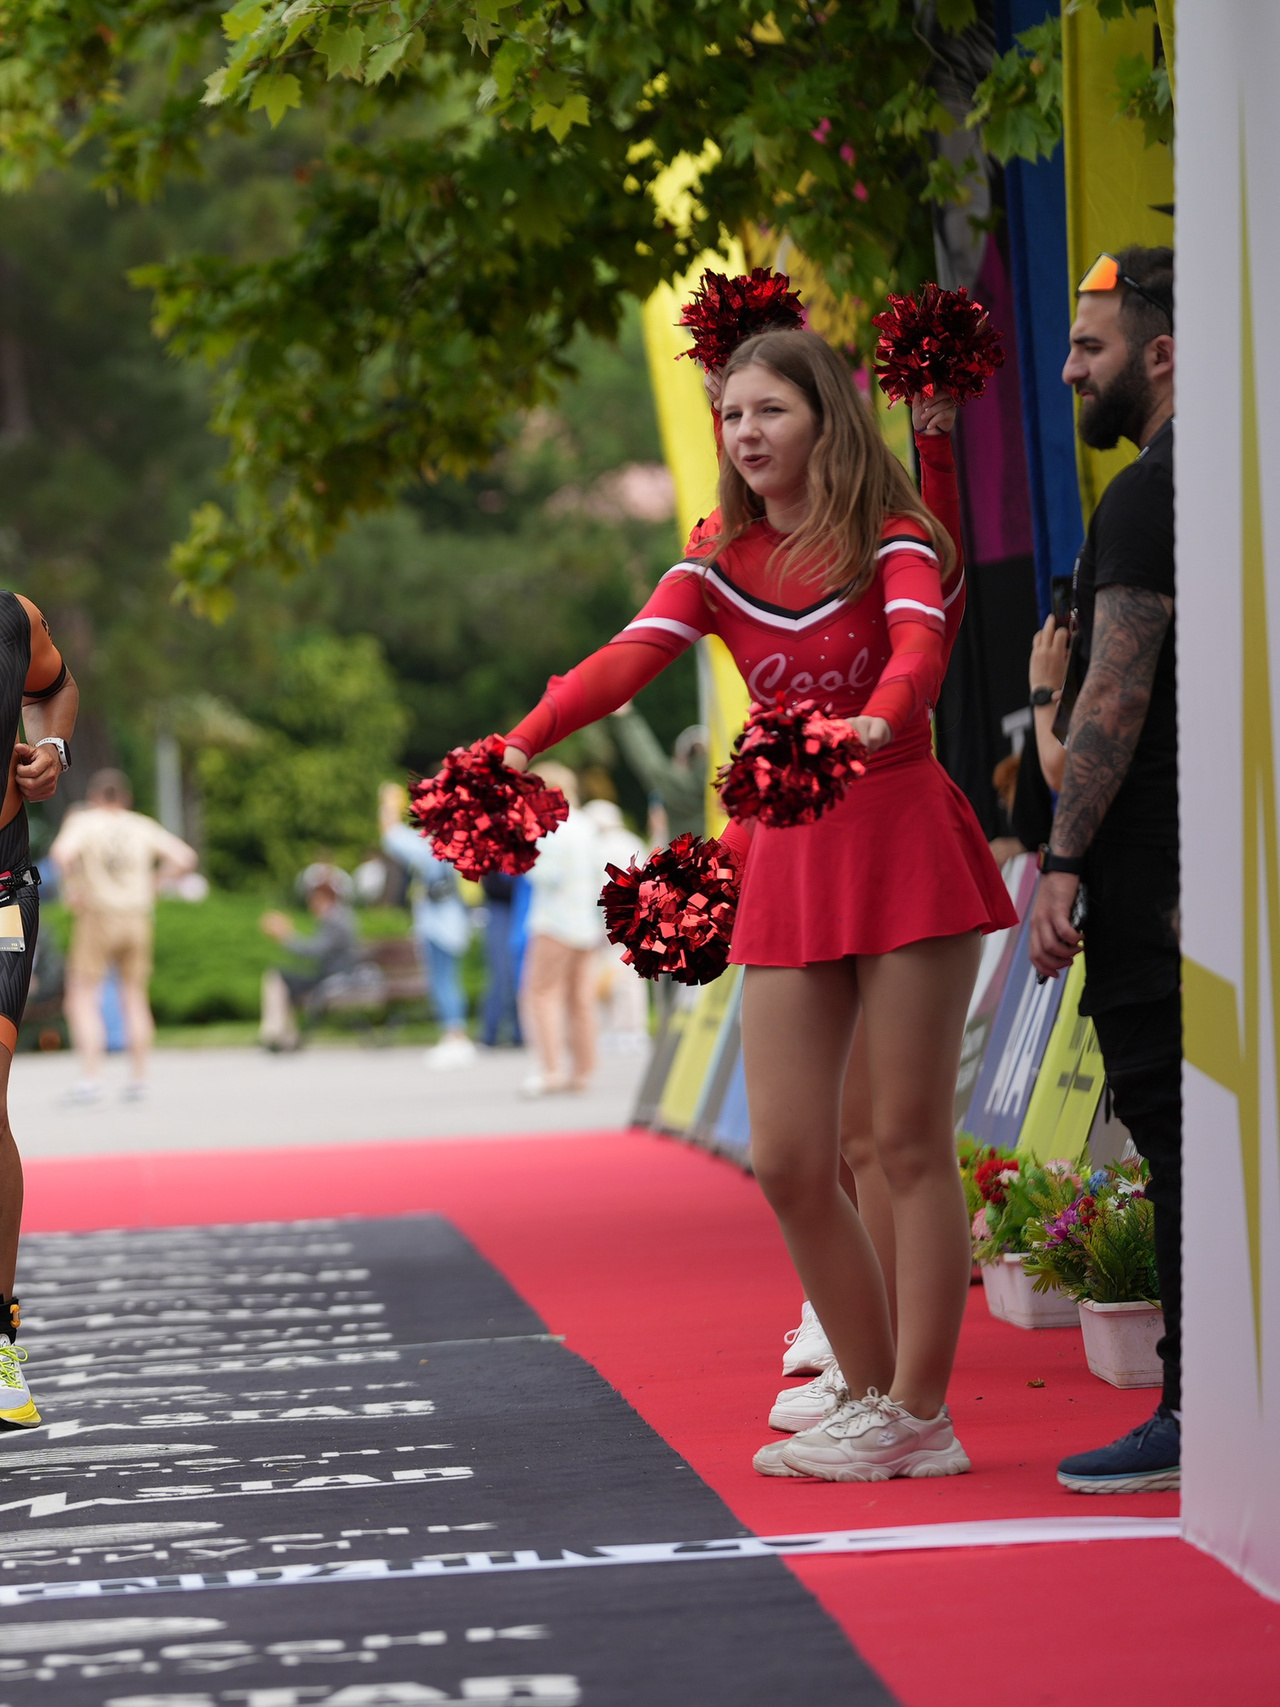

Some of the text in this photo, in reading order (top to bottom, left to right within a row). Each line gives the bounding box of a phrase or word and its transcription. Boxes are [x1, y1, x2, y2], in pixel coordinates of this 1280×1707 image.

[748, 647, 873, 704] Cool
[138, 1400, 436, 1425] STAR
[134, 1466, 474, 1498] STAR
